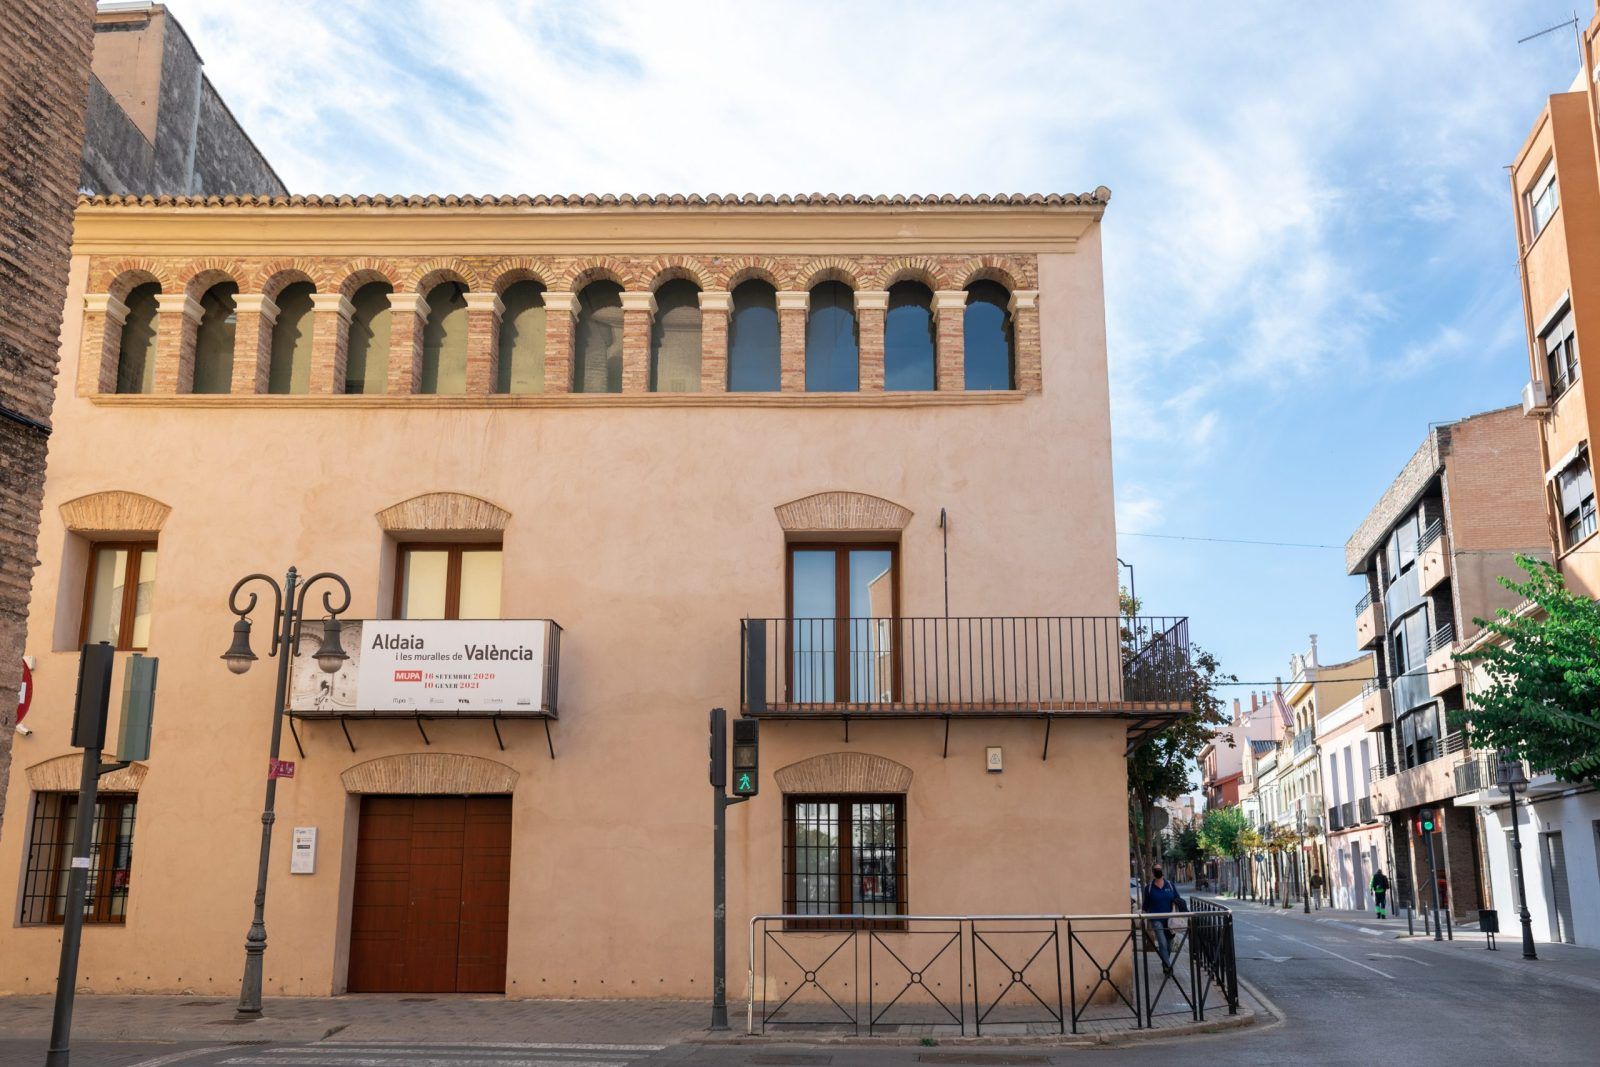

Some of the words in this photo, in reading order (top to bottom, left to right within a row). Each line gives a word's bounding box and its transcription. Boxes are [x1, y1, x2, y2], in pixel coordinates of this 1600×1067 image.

[371, 633, 425, 650] Aldaia
[400, 652, 413, 661] les
[414, 652, 450, 661] muralles
[452, 652, 463, 661] de
[464, 644, 533, 661] València
[395, 672, 421, 681] MUPA
[473, 673, 495, 681] 2020
